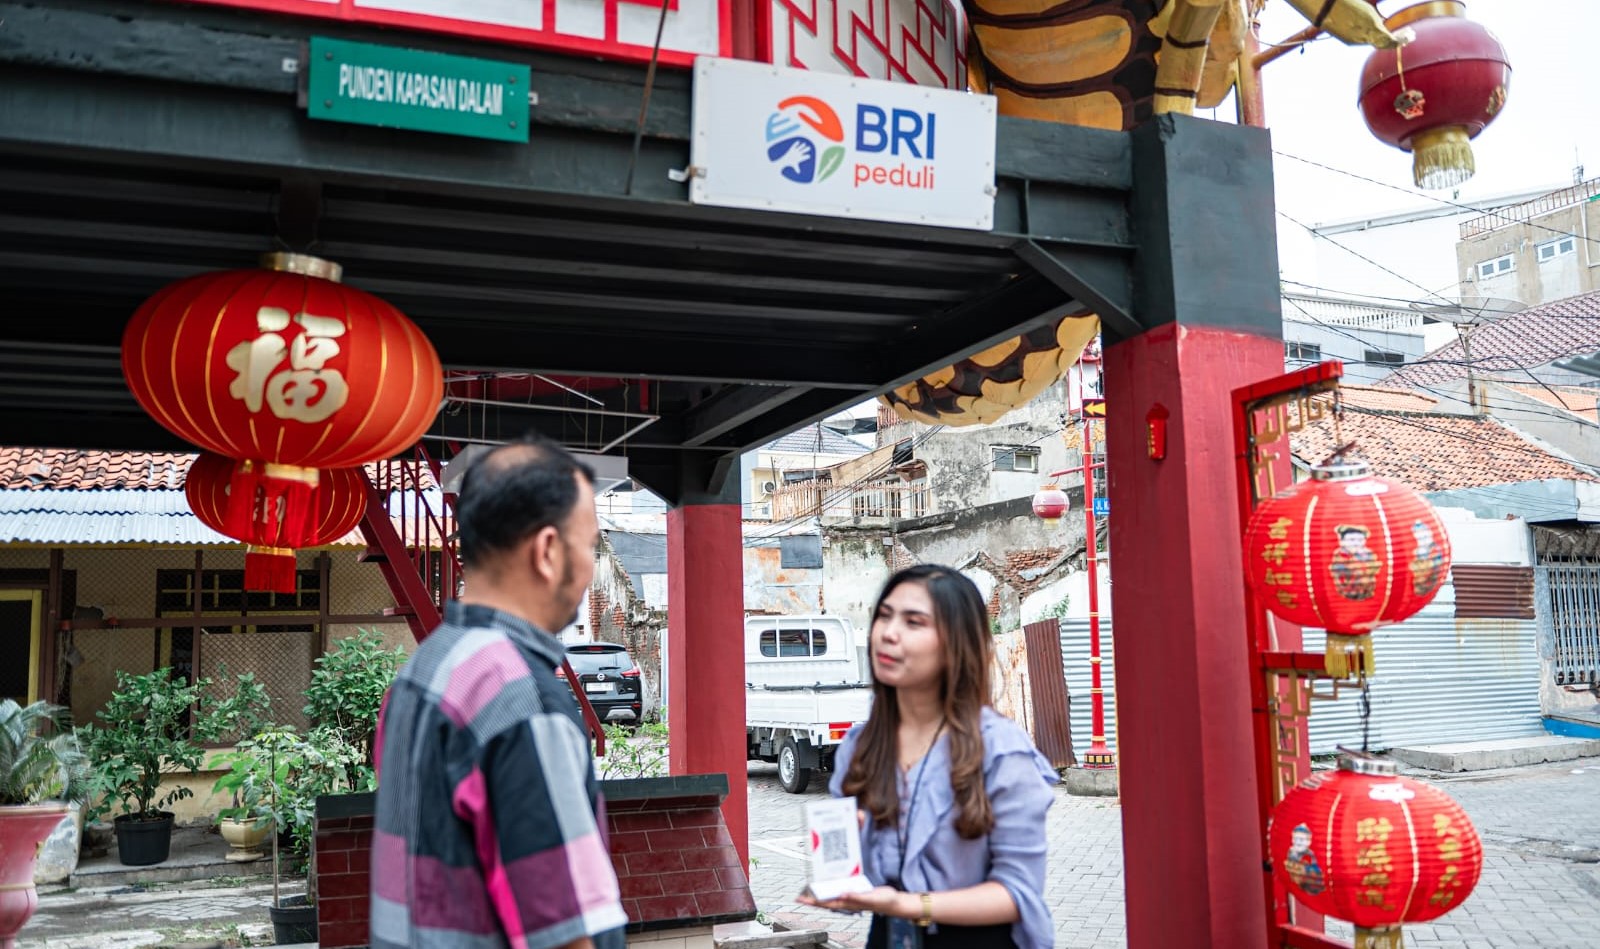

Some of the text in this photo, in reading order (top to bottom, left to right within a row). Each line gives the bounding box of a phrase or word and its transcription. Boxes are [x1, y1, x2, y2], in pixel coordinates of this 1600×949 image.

[339, 63, 503, 116] PUNDEN KAPASAN DALAM
[855, 103, 936, 160] BRI
[854, 163, 935, 190] peduli
[226, 306, 349, 424] 福
